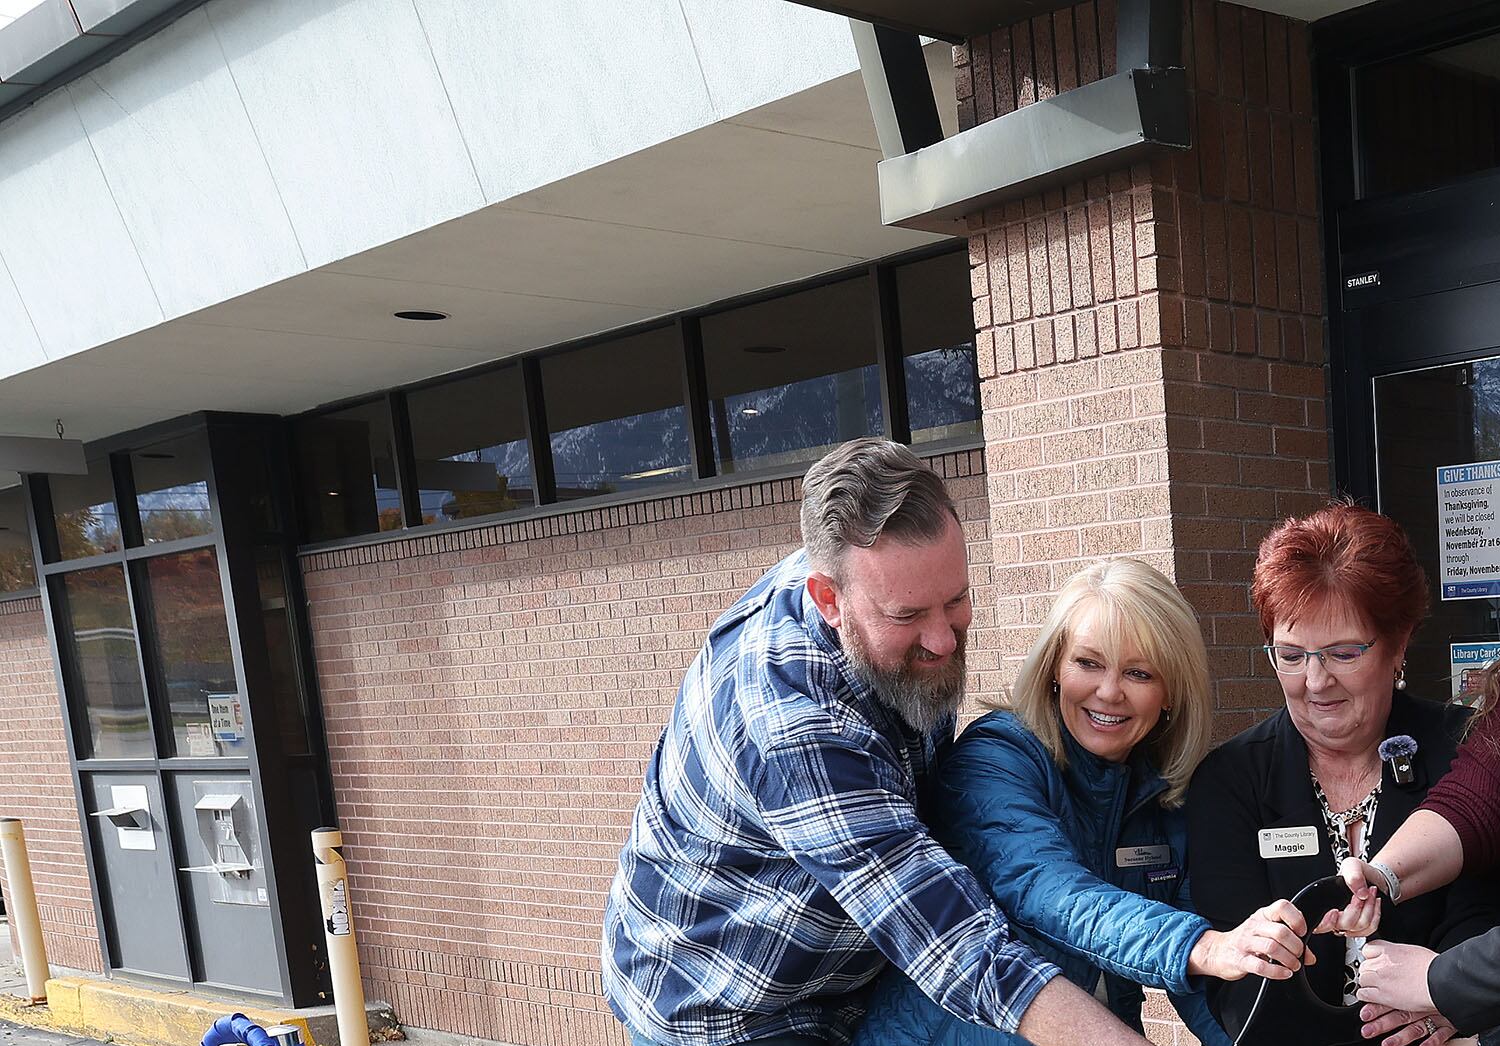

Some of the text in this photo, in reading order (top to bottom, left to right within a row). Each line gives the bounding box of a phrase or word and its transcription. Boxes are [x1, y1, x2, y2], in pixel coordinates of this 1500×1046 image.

[1348, 274, 1377, 287] STANLEY
[1444, 468, 1465, 482] GIVE
[1444, 484, 1493, 498] In observance of
[1445, 500, 1489, 512] Thanksgiving,
[1445, 510, 1494, 524] we will be closed
[1446, 527, 1484, 538] Wednesday,
[1446, 540, 1478, 550] November
[1479, 539, 1487, 548] 27
[1488, 539, 1495, 548] at
[1496, 538, 1500, 547] 6
[1446, 553, 1470, 564] through
[1447, 567, 1468, 577] Friday,
[1454, 649, 1479, 660] Library
[1480, 648, 1496, 658] Card
[1275, 843, 1305, 852] Maggie
